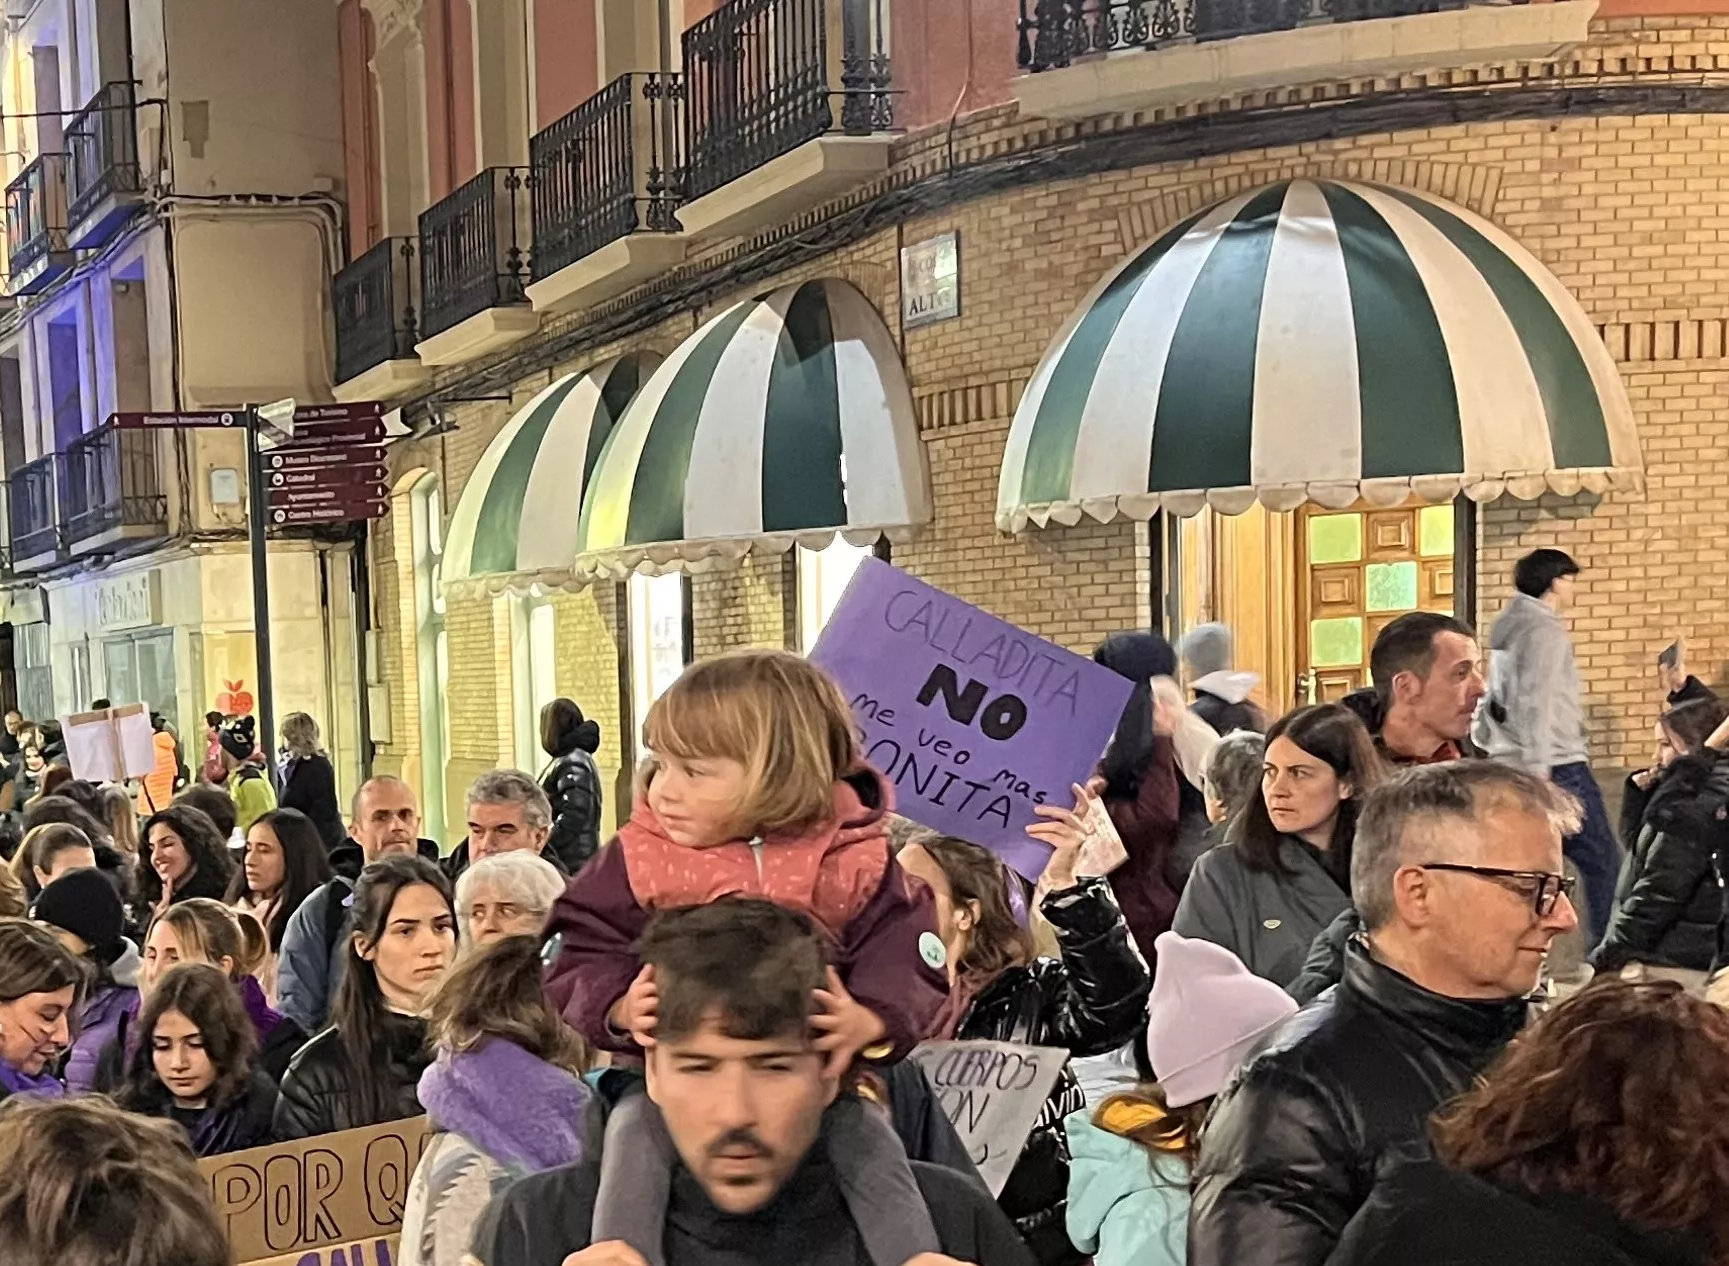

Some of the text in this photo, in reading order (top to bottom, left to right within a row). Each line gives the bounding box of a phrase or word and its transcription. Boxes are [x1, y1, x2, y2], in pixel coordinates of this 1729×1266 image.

[884, 590, 1081, 717] CALLADITA
[915, 663, 1028, 741] NO
[918, 728, 971, 765] veo
[993, 768, 1049, 804] mas
[935, 1049, 1041, 1091] CUERPOS
[212, 1148, 344, 1251] POR
